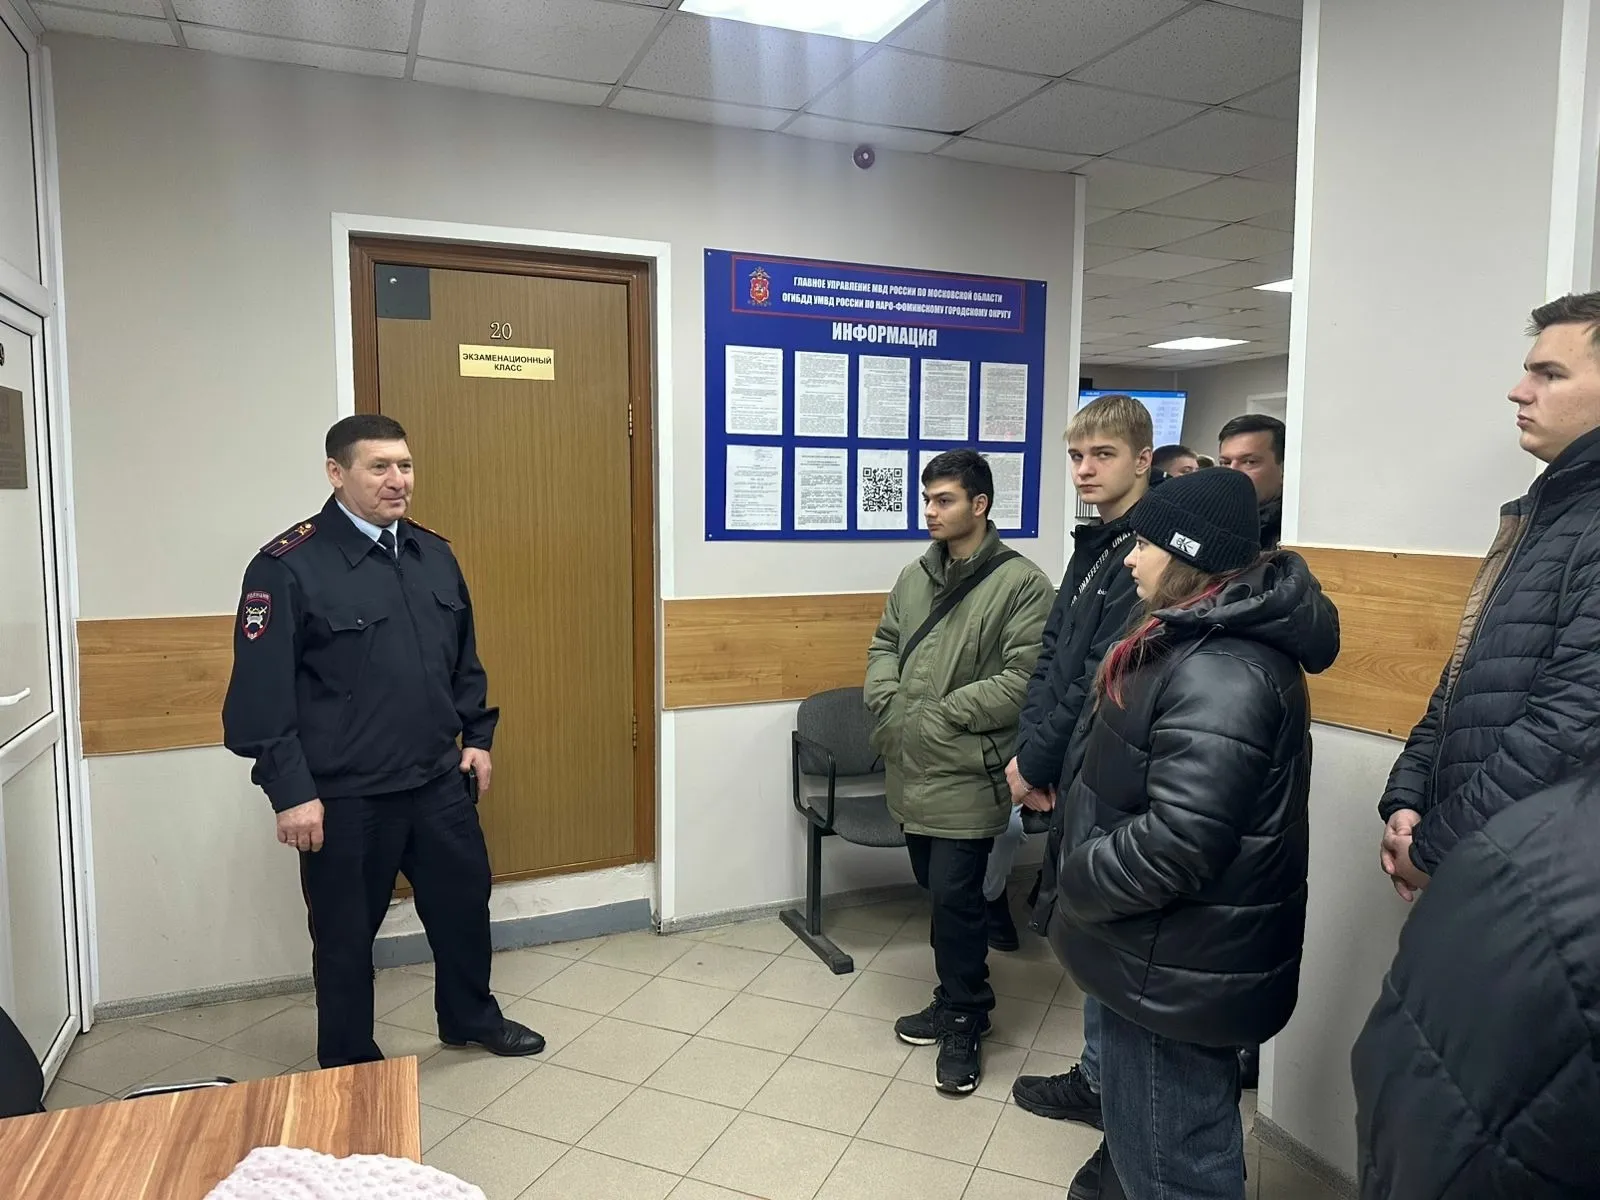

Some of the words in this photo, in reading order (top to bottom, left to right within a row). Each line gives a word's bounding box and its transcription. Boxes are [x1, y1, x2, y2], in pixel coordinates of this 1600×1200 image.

[793, 276, 826, 288] ГЛАВНОЕ
[827, 279, 871, 292] УПРАВЛЕНИЕ
[872, 283, 889, 295] МВД
[889, 285, 917, 297] РОССИИ
[917, 287, 927, 297] ПО
[927, 288, 972, 301] МОСКОВСКОЙ
[973, 292, 1003, 304] ОБЛАСТИ
[782, 292, 813, 305] ОГИБДД
[813, 294, 835, 307] УМВД
[835, 297, 864, 309] РОССИИ
[864, 299, 875, 309] ПО
[875, 300, 944, 314] НАРО-ФОМИНСКОМУ
[944, 305, 987, 318] ГОРОДСКОМУ
[988, 308, 1012, 319] ОКРУГУ
[489, 321, 513, 341] 20
[832, 321, 938, 349] ИНФОРМАЦИЯ
[462, 352, 552, 365] ЭКЗАМЕНАЦИОННЫЙ
[494, 363, 522, 372] КЛАСС
